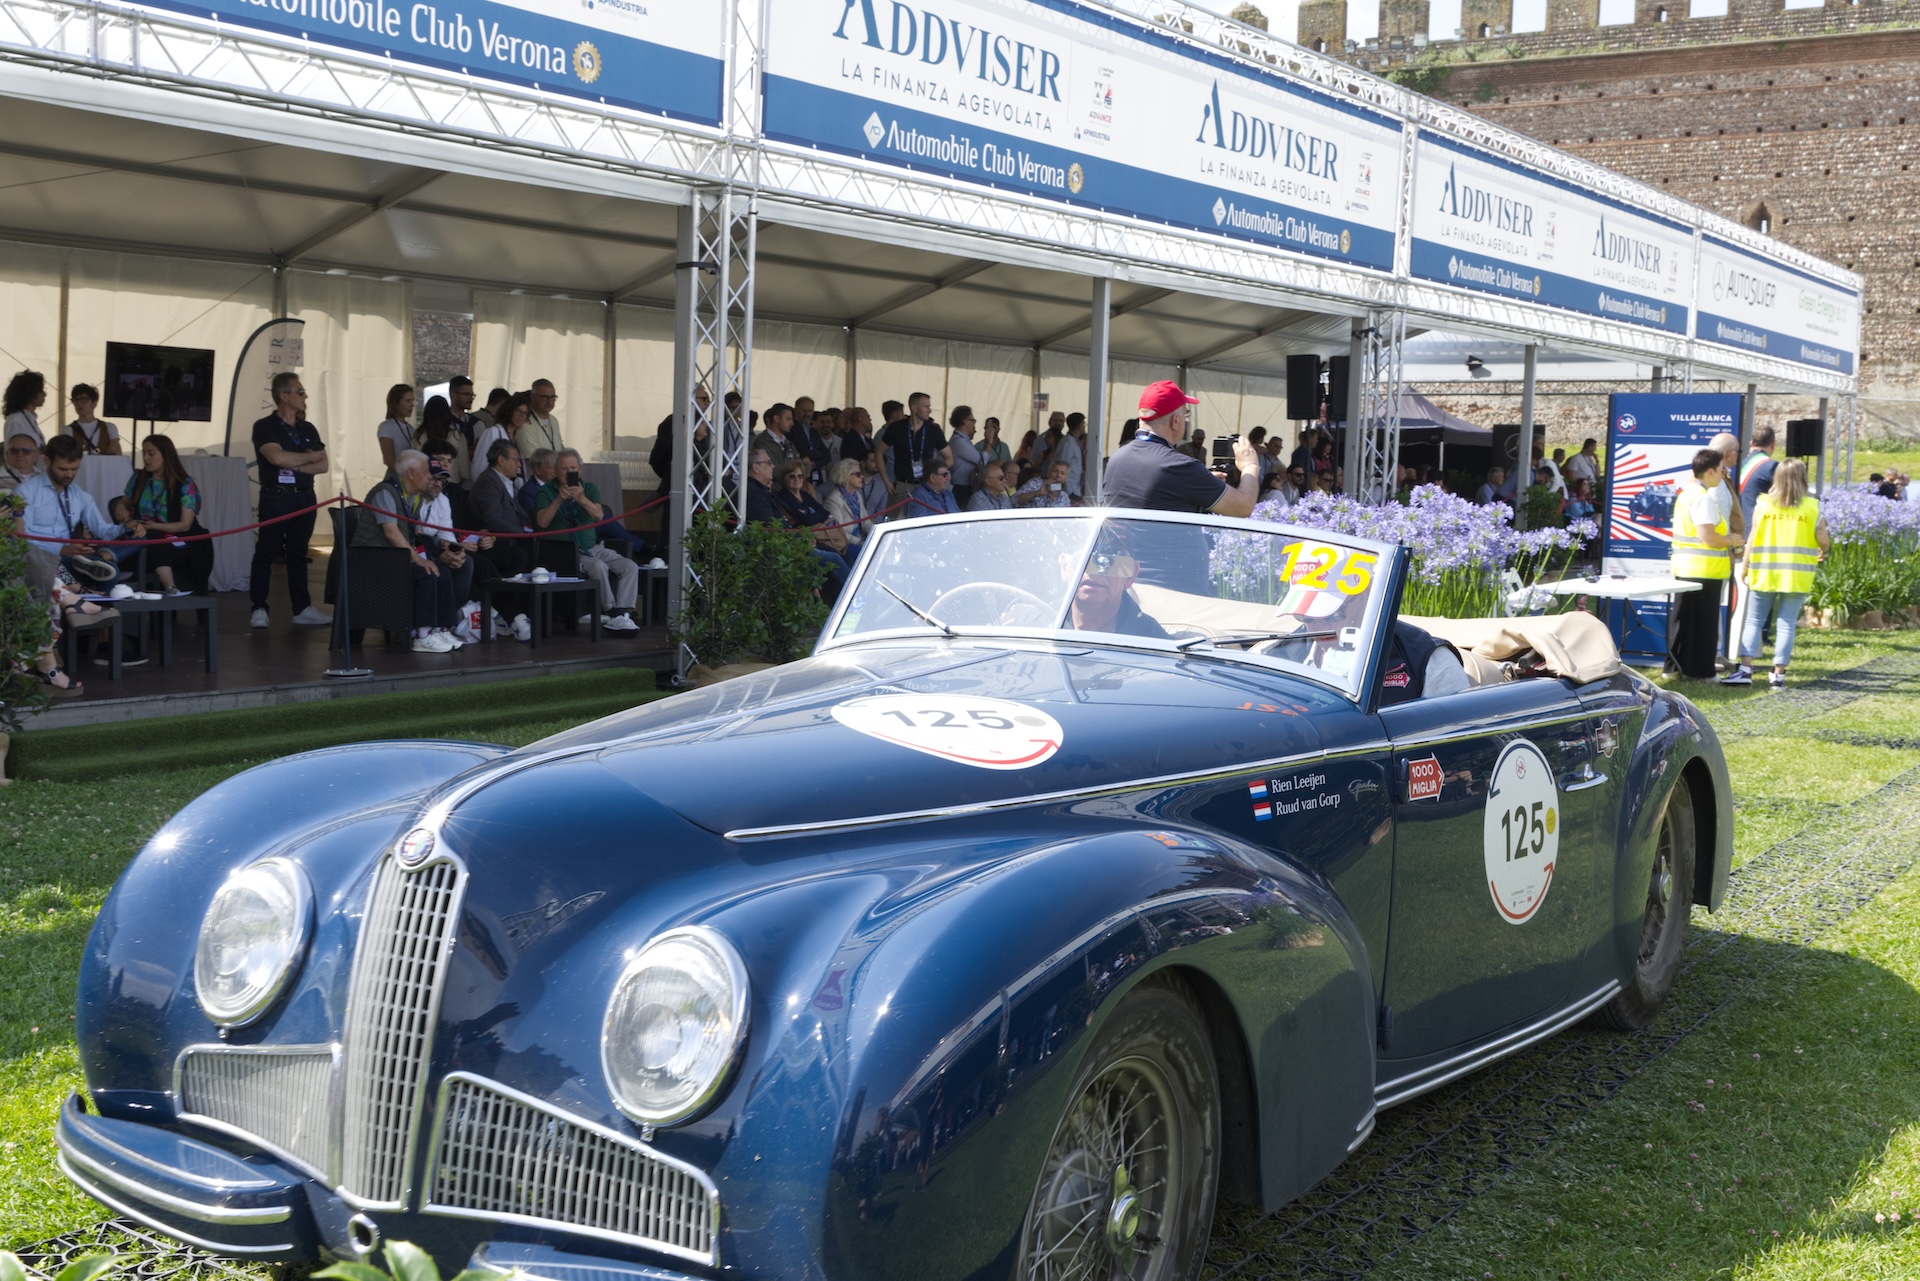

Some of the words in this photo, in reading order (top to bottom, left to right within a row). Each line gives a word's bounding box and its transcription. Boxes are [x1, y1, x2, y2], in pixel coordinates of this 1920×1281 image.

[410, 3, 473, 54] Club
[478, 21, 567, 75] Verona
[842, 57, 863, 83] LA
[873, 66, 949, 106] FINANZA
[957, 92, 1052, 133] AGEVOLATA
[1196, 78, 1338, 182] ADDVISER
[886, 120, 978, 170] Automobile
[982, 142, 1016, 178] Club
[1018, 152, 1065, 190] Verona
[1200, 157, 1214, 176] LA
[1219, 162, 1267, 190] FINANZA
[1272, 178, 1331, 208] AGEVOLATA
[1439, 160, 1533, 238] ADDVISER
[1226, 203, 1284, 239] Automobile
[1285, 217, 1307, 245] Club
[1308, 222, 1339, 251] Verona
[1441, 223, 1451, 237] LA
[1453, 226, 1485, 247] FINANZA
[1488, 236, 1528, 258] AGEVOLATA
[1592, 211, 1661, 275] ADDVISER
[1457, 259, 1496, 286] Automobile
[1496, 267, 1511, 289] Club
[1511, 271, 1533, 294] Verona
[1605, 295, 1633, 317] Automobile
[1669, 414, 1732, 422] VILLAFRANCA
[1763, 514, 1808, 523] MARSHAL
[1279, 541, 1378, 595] 125
[881, 709, 1015, 730] 125
[1271, 778, 1292, 794] Rien
[1293, 773, 1326, 790] Leeijen
[1411, 764, 1435, 778] 1000
[1412, 779, 1438, 795] MIGLIA
[1276, 800, 1300, 817] Ruud
[1301, 798, 1318, 810] van
[1318, 792, 1341, 808] Gorp
[1501, 801, 1545, 862] 125
